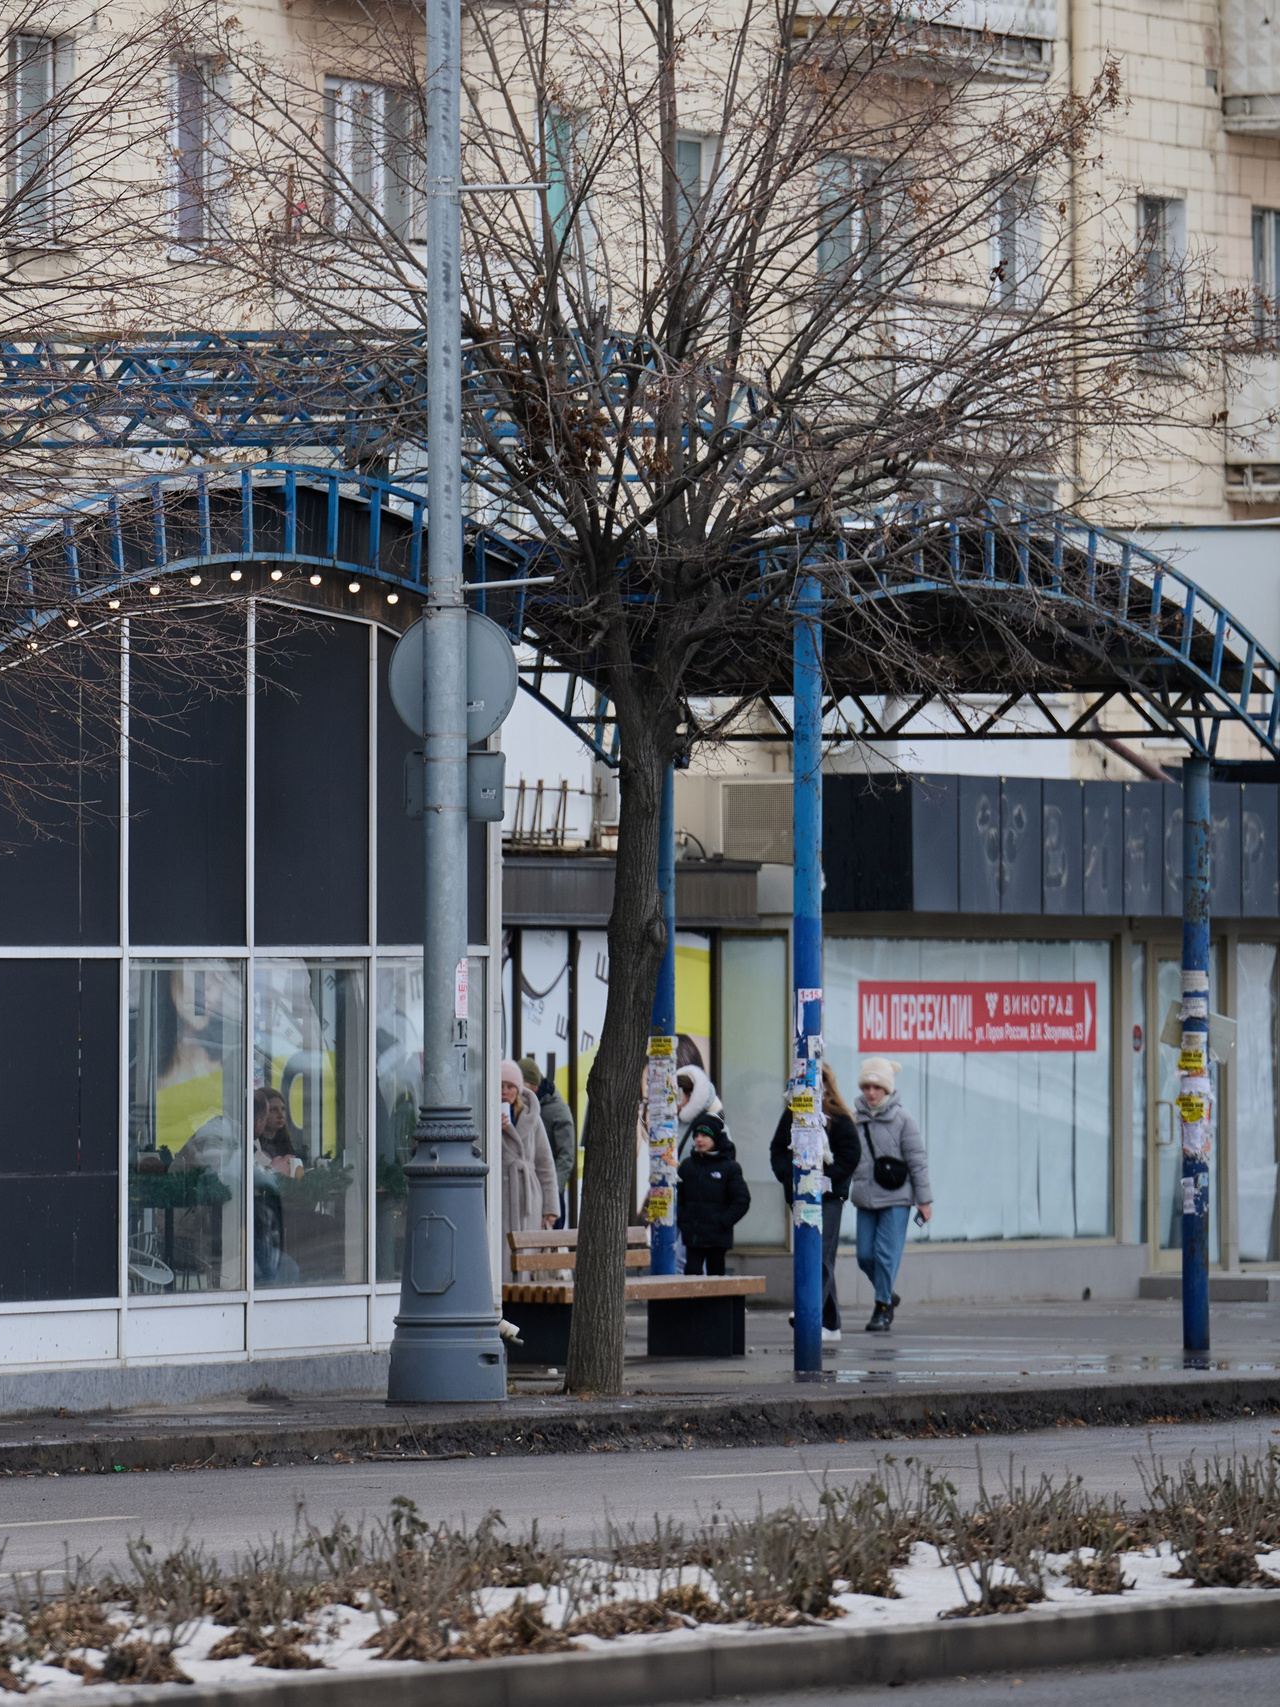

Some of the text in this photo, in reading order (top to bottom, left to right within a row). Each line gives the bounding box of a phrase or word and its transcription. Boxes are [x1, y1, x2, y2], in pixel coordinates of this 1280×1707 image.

[862, 993, 973, 1041] МЫ ПЕРЕЕХАЛИ!
[1003, 994, 1074, 1016] ВИНОГРАД
